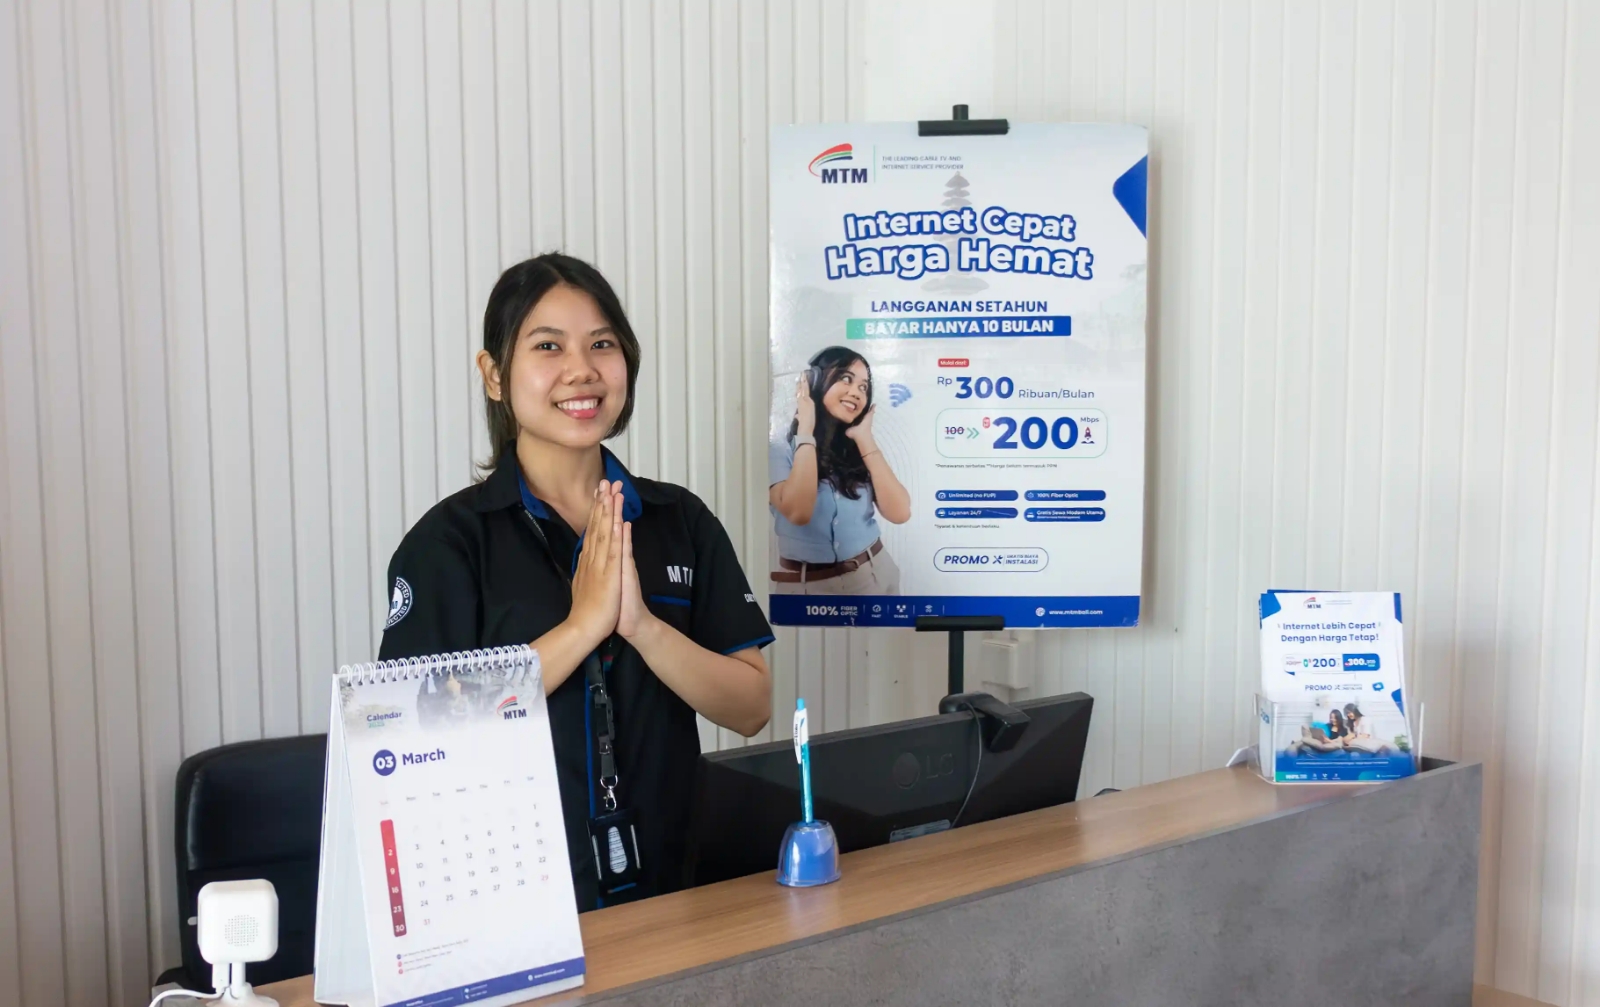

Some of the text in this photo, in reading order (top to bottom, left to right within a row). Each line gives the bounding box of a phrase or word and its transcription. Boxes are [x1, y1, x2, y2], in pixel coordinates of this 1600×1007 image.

[821, 168, 868, 184] MTM
[845, 207, 1075, 241] Internet Cepat
[826, 239, 1093, 279] Harga Hemat
[871, 300, 1048, 313] LANGGANAN SETAHUN
[865, 320, 1054, 334] BAYAR HANYA 10 BULAN
[937, 376, 1095, 400] Rp 300 Ribuan/Bulan
[945, 426, 964, 434] 100
[992, 416, 1079, 450] 200
[944, 555, 989, 564] PROMO
[666, 566, 693, 587] MT
[806, 605, 838, 616] 100%
[1348, 622, 1376, 631] Cepat
[1281, 633, 1379, 643] Dengan Harga Tetap!
[1312, 658, 1336, 667] 200
[366, 712, 402, 722] Calendar
[504, 709, 527, 720] MTM
[376, 748, 445, 770] 03 March
